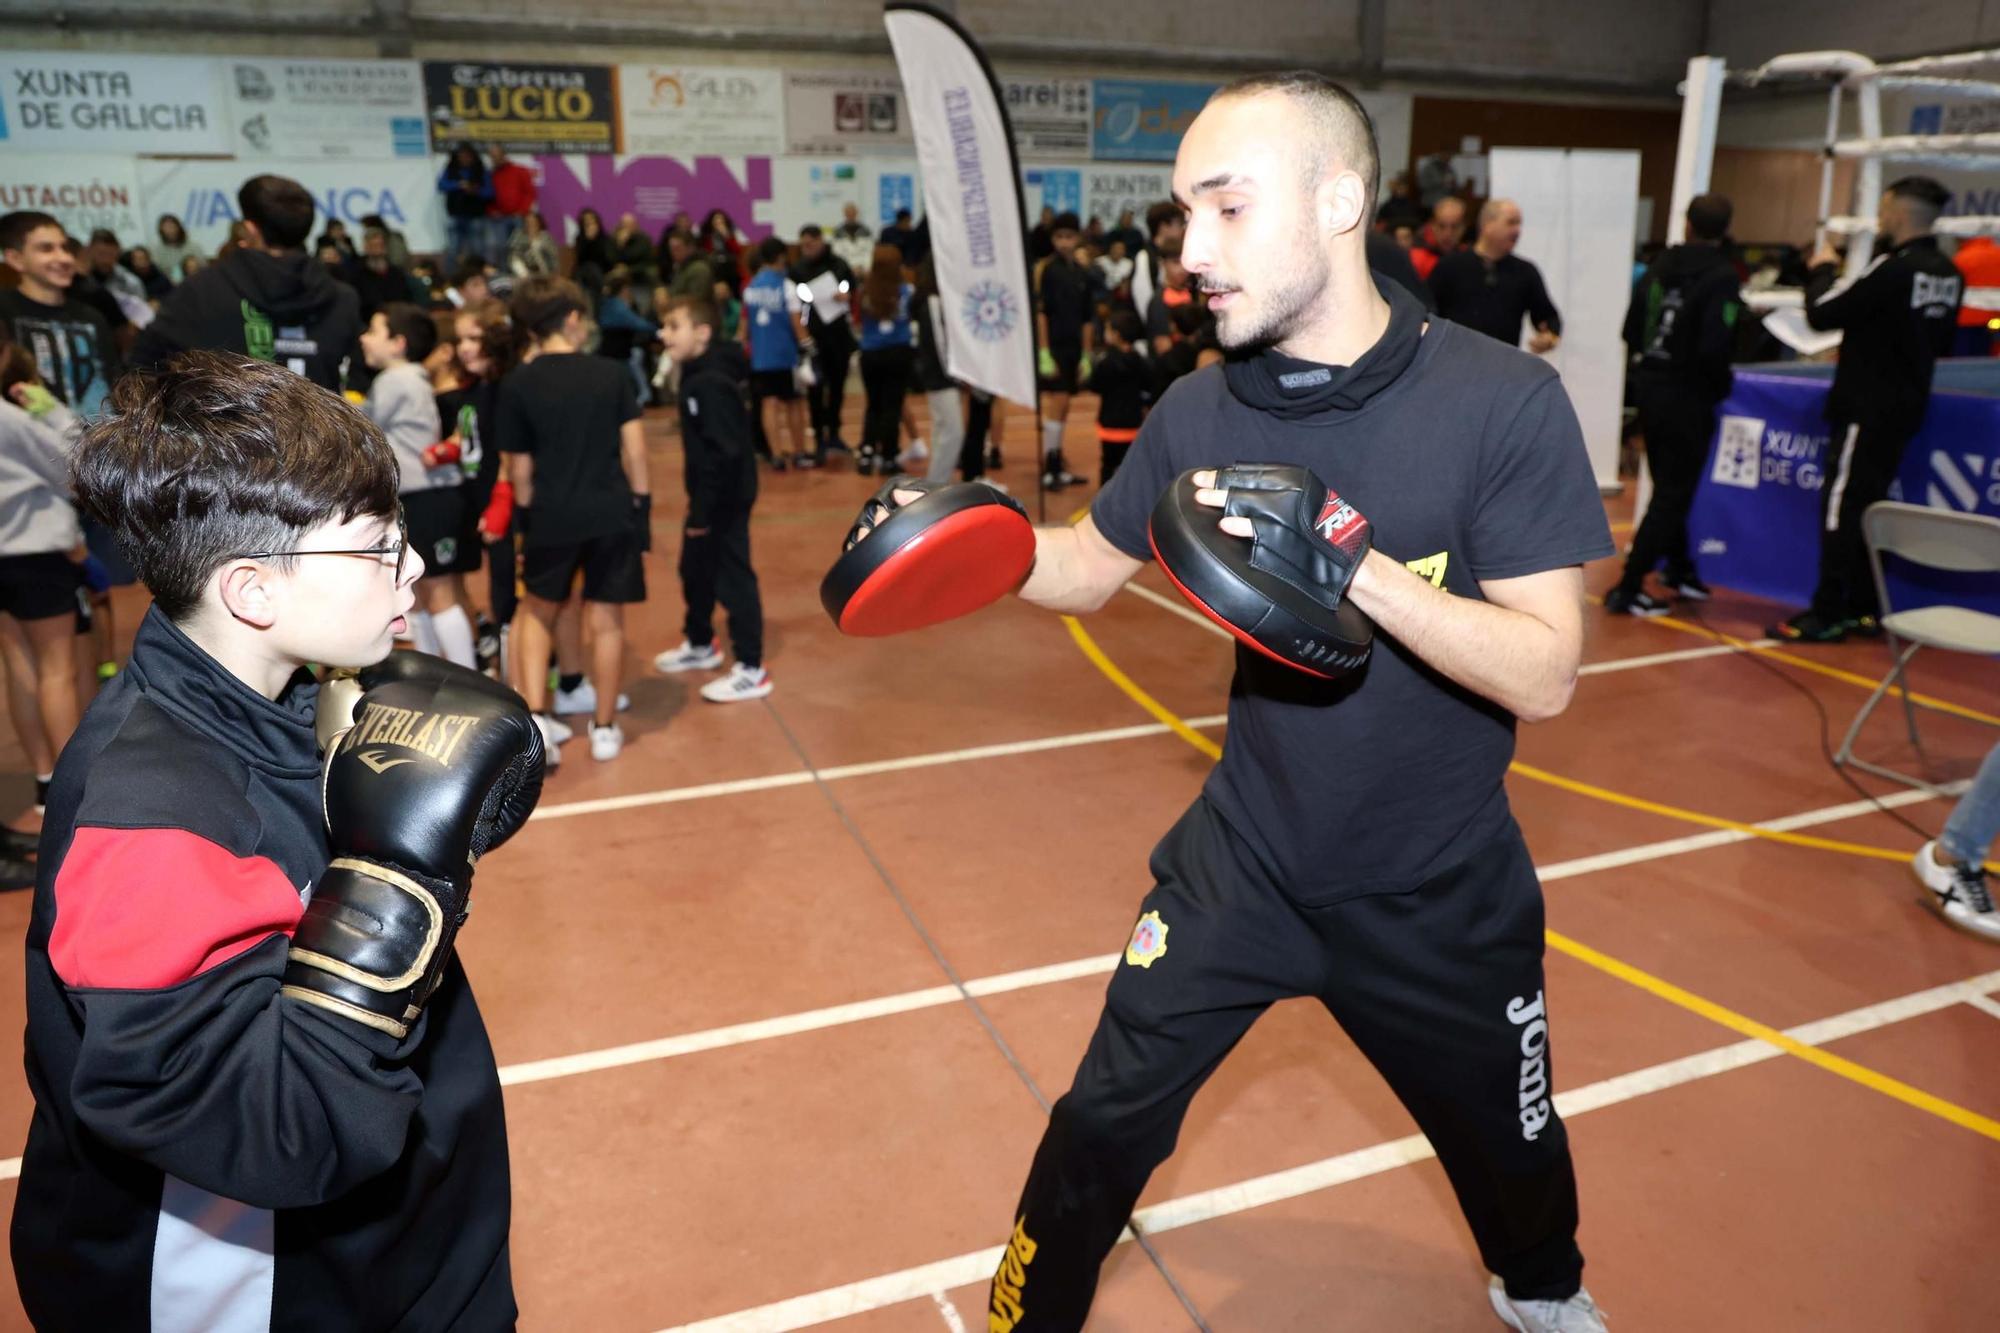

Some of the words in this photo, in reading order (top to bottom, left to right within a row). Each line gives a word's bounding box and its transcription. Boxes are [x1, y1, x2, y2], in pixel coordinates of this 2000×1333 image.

[13, 69, 132, 99] XUNTA
[452, 64, 585, 88] Taberna
[19, 103, 64, 129] DE
[71, 103, 207, 131] GALICIA
[449, 85, 594, 121] LUCIO
[1090, 174, 1163, 195] XUNTA
[208, 187, 406, 225] ANCA
[1761, 458, 1792, 486] DE
[342, 702, 480, 767] EVERLAST
[1505, 989, 1551, 1142] Joma
